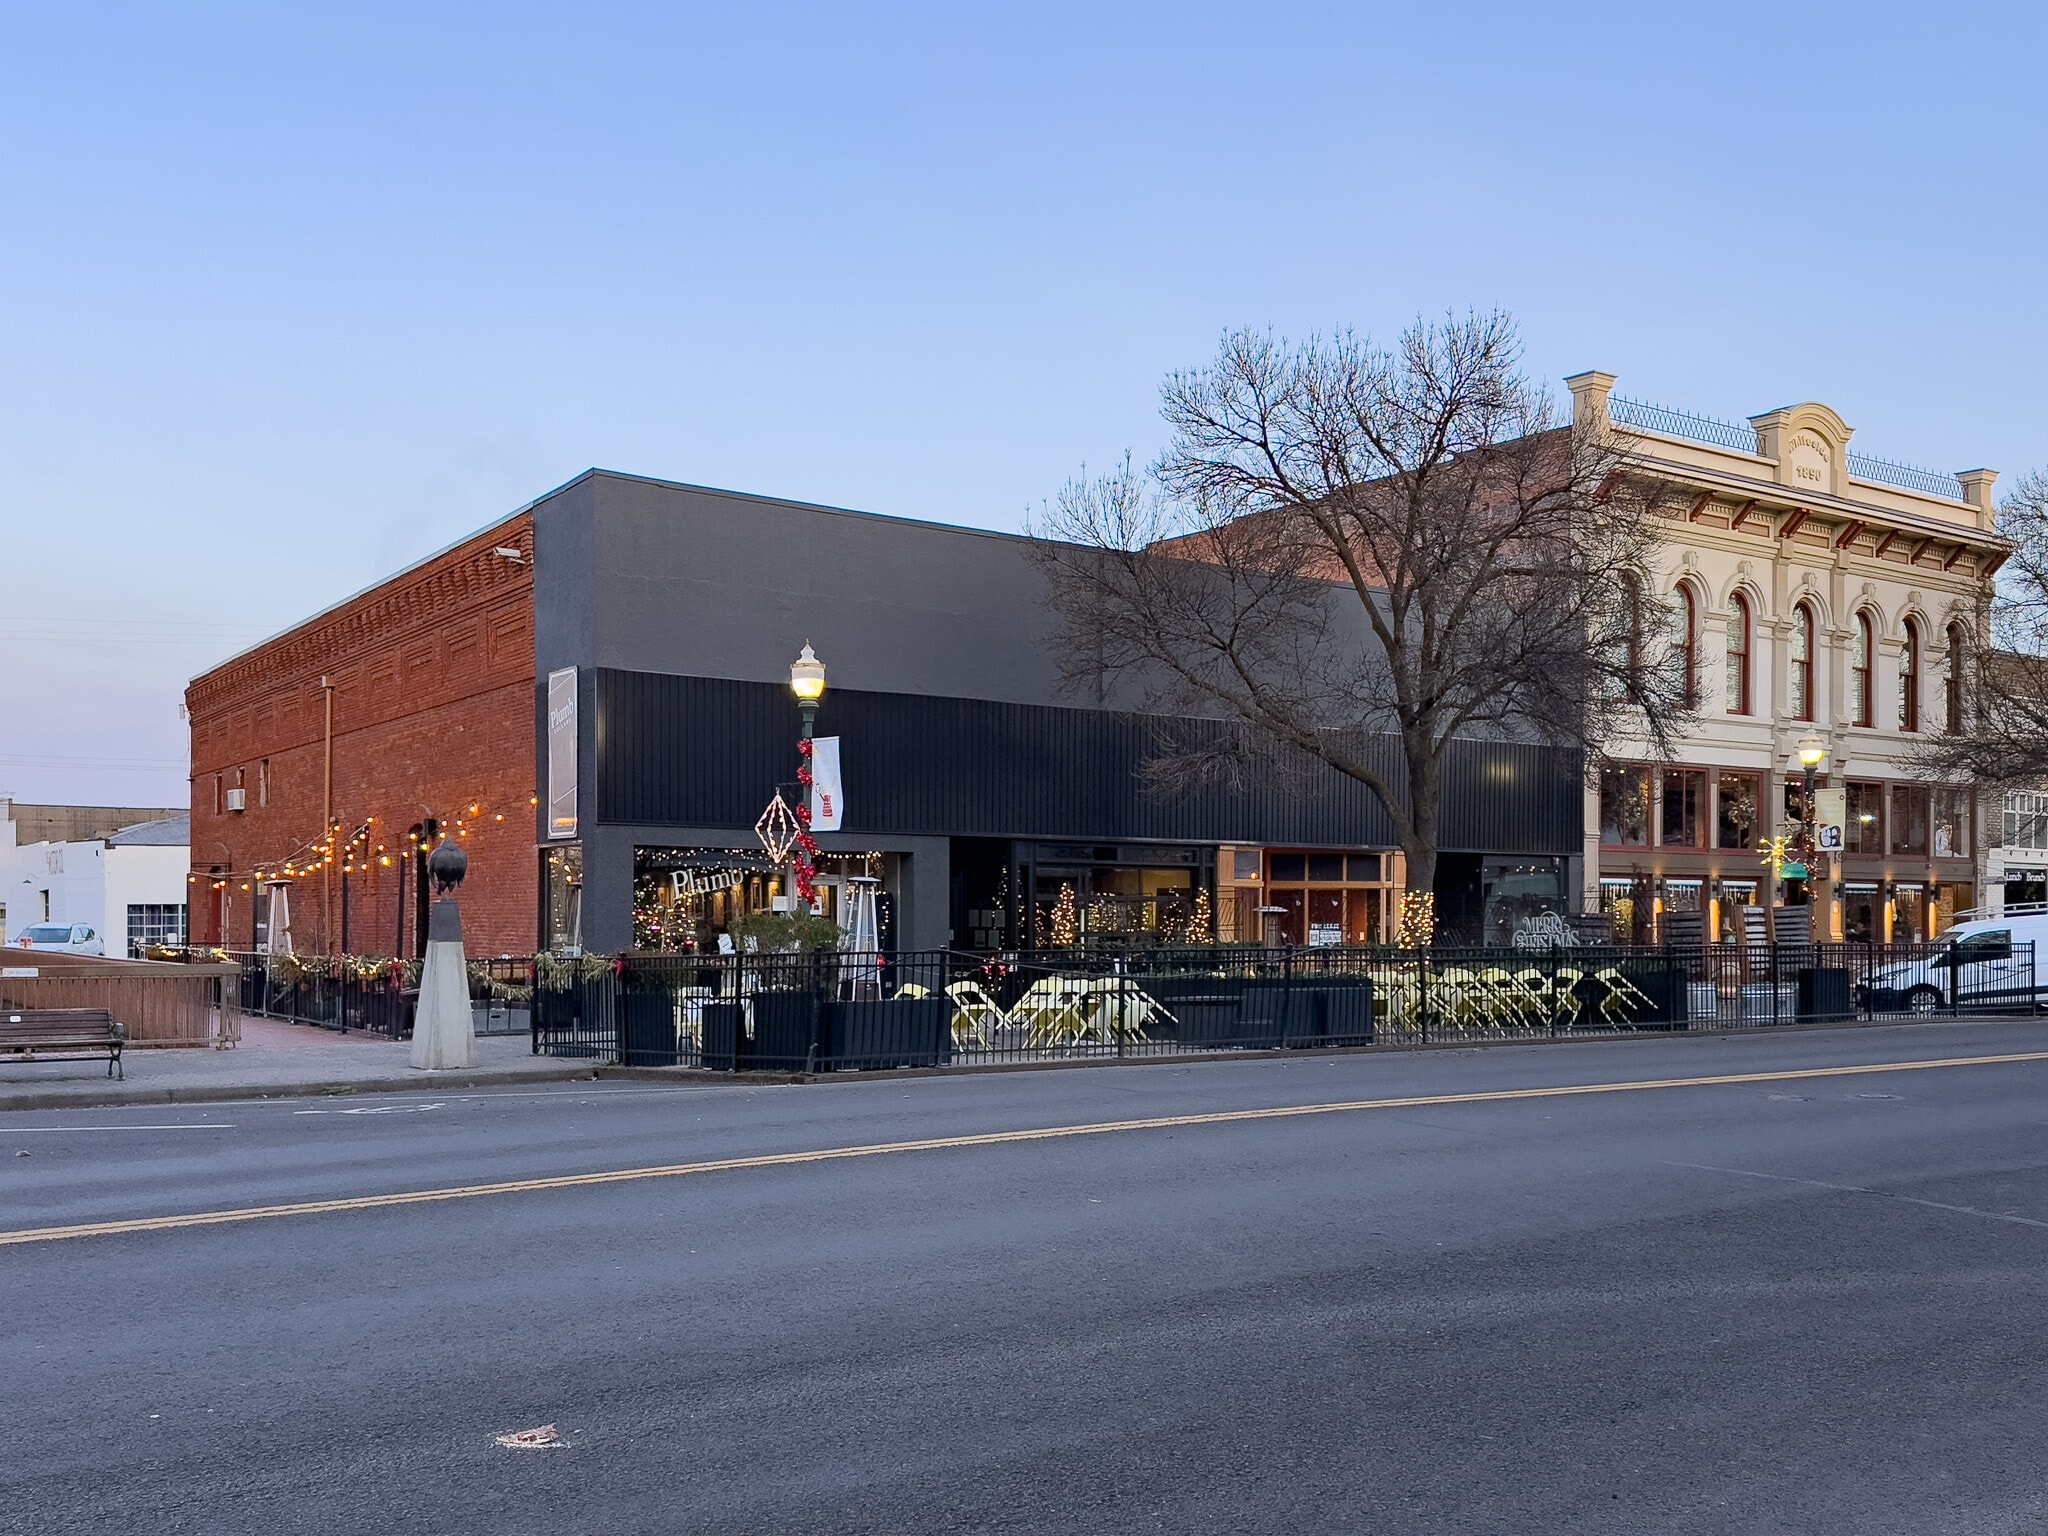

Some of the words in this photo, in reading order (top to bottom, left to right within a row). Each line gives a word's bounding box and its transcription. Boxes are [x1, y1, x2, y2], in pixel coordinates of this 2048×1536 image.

[1796, 465, 1821, 481] 1890
[551, 697, 573, 729] Plumb
[669, 859, 744, 900] Plumb
[1522, 911, 1570, 935] MERRY
